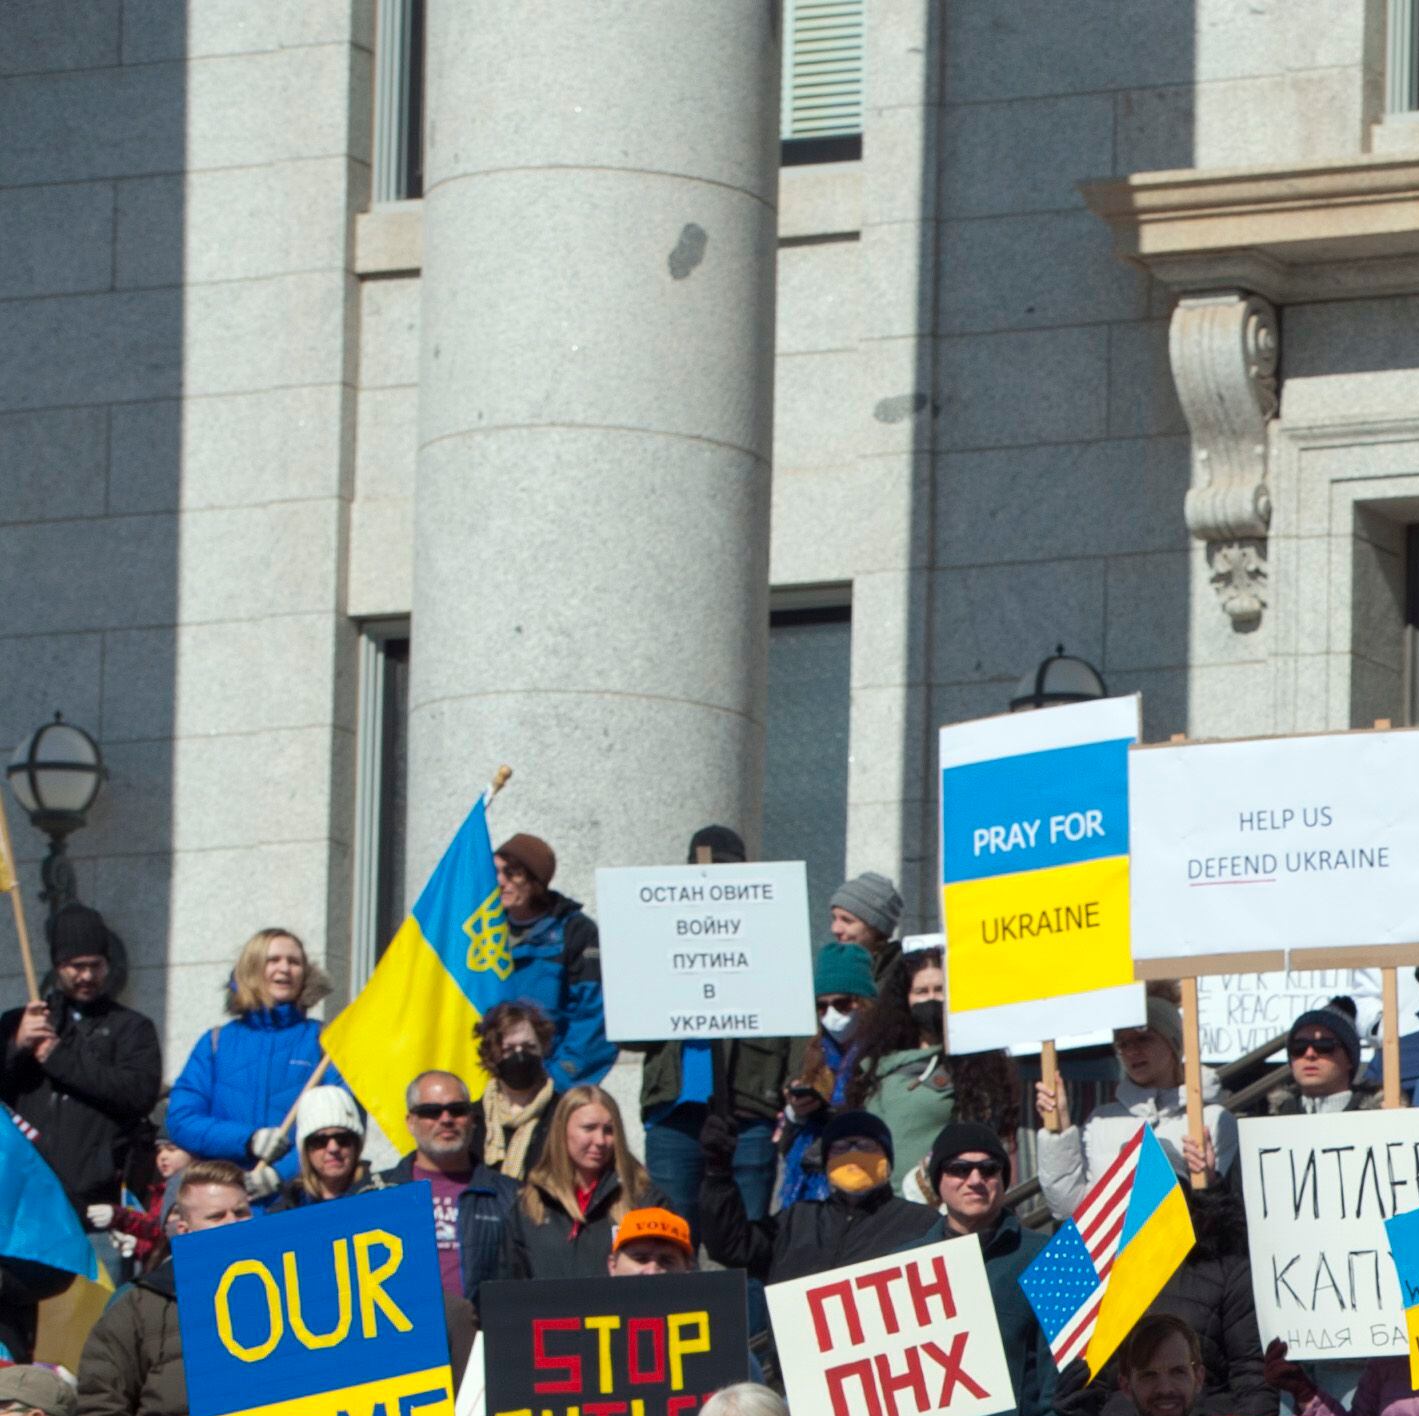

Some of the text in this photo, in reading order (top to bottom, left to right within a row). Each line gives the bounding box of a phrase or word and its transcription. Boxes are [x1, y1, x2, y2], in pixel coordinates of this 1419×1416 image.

[972, 808, 1106, 858] PRAY FOR
[1239, 805, 1333, 833] HELP US
[1187, 846, 1391, 881] DEFEND UKRAINE
[640, 883, 774, 903] ОСТАН ОВИТЕ
[676, 915, 741, 936] ВОЙНУ
[981, 901, 1101, 946] UKRAINE
[673, 952, 749, 970] ПУТИНА
[670, 1013, 759, 1032] УКРАИНЕ
[213, 1228, 415, 1364] OUR
[1271, 1249, 1396, 1312] КАП
[805, 1255, 958, 1353] ПТН
[533, 1310, 711, 1395] STOP
